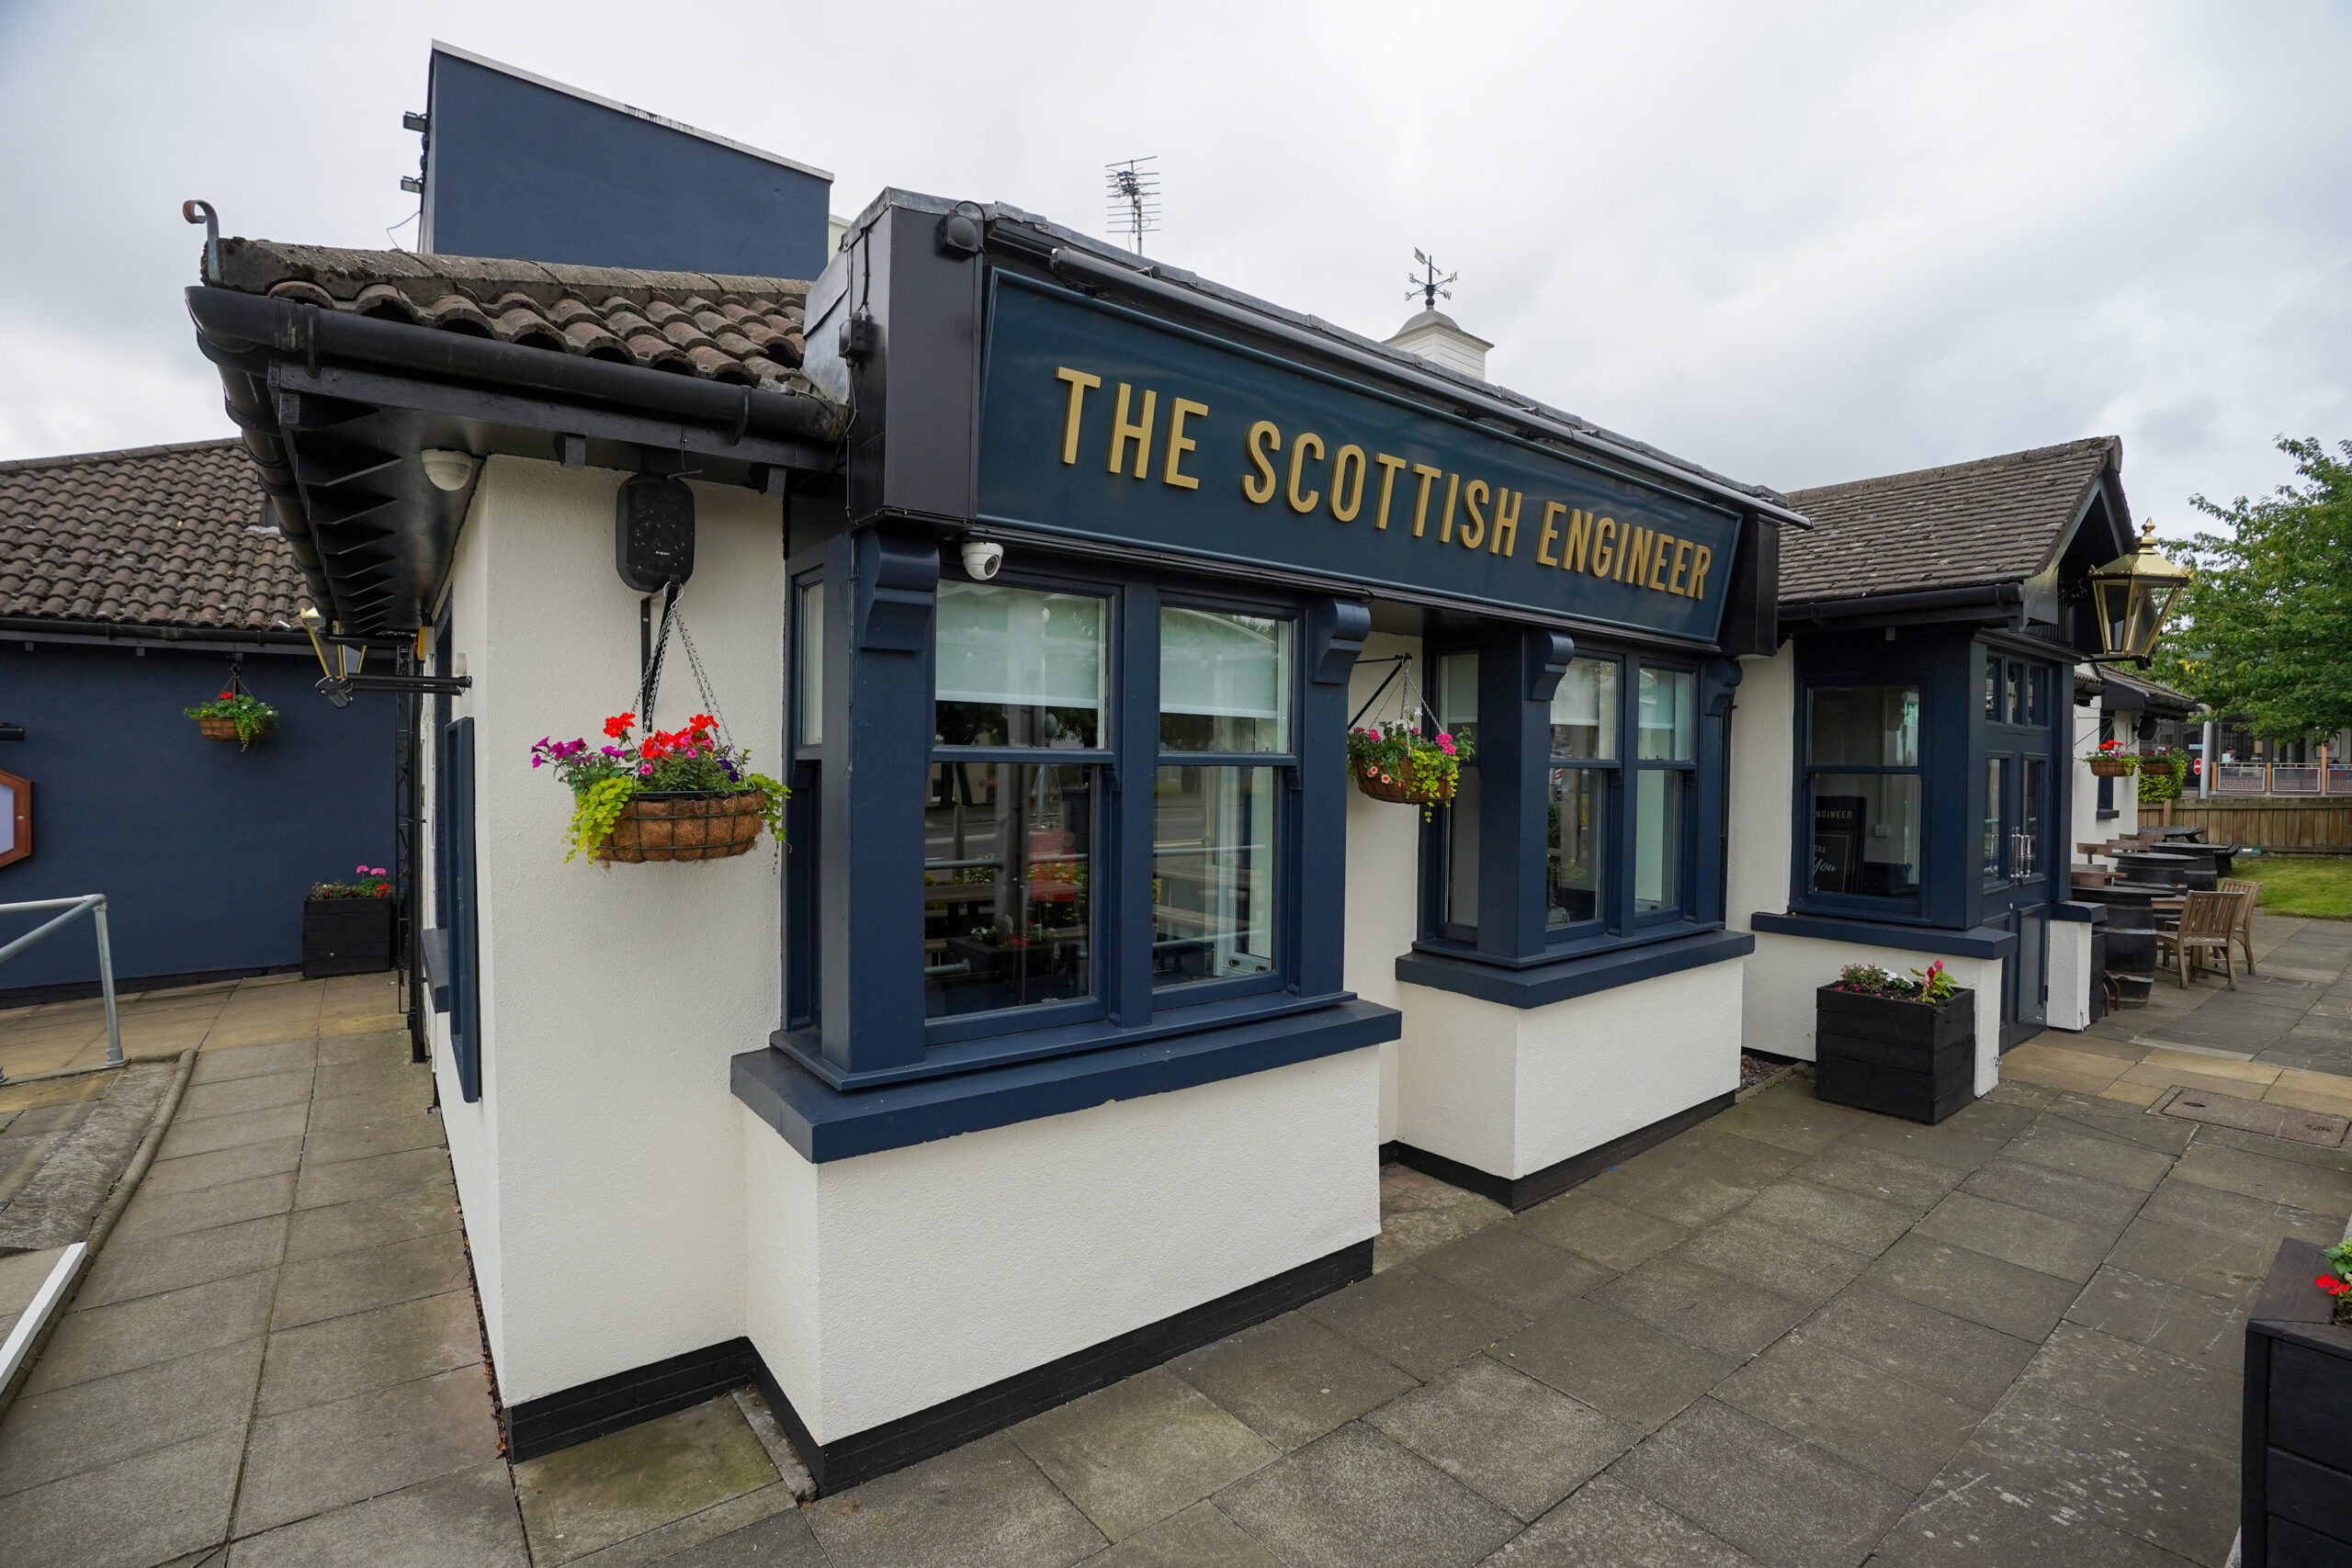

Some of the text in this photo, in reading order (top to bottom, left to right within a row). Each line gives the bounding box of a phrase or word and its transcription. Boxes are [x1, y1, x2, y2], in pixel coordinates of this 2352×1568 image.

[1056, 367, 1712, 601] THE SCOTTISH ENGINEER
[1813, 856, 1837, 874] You
